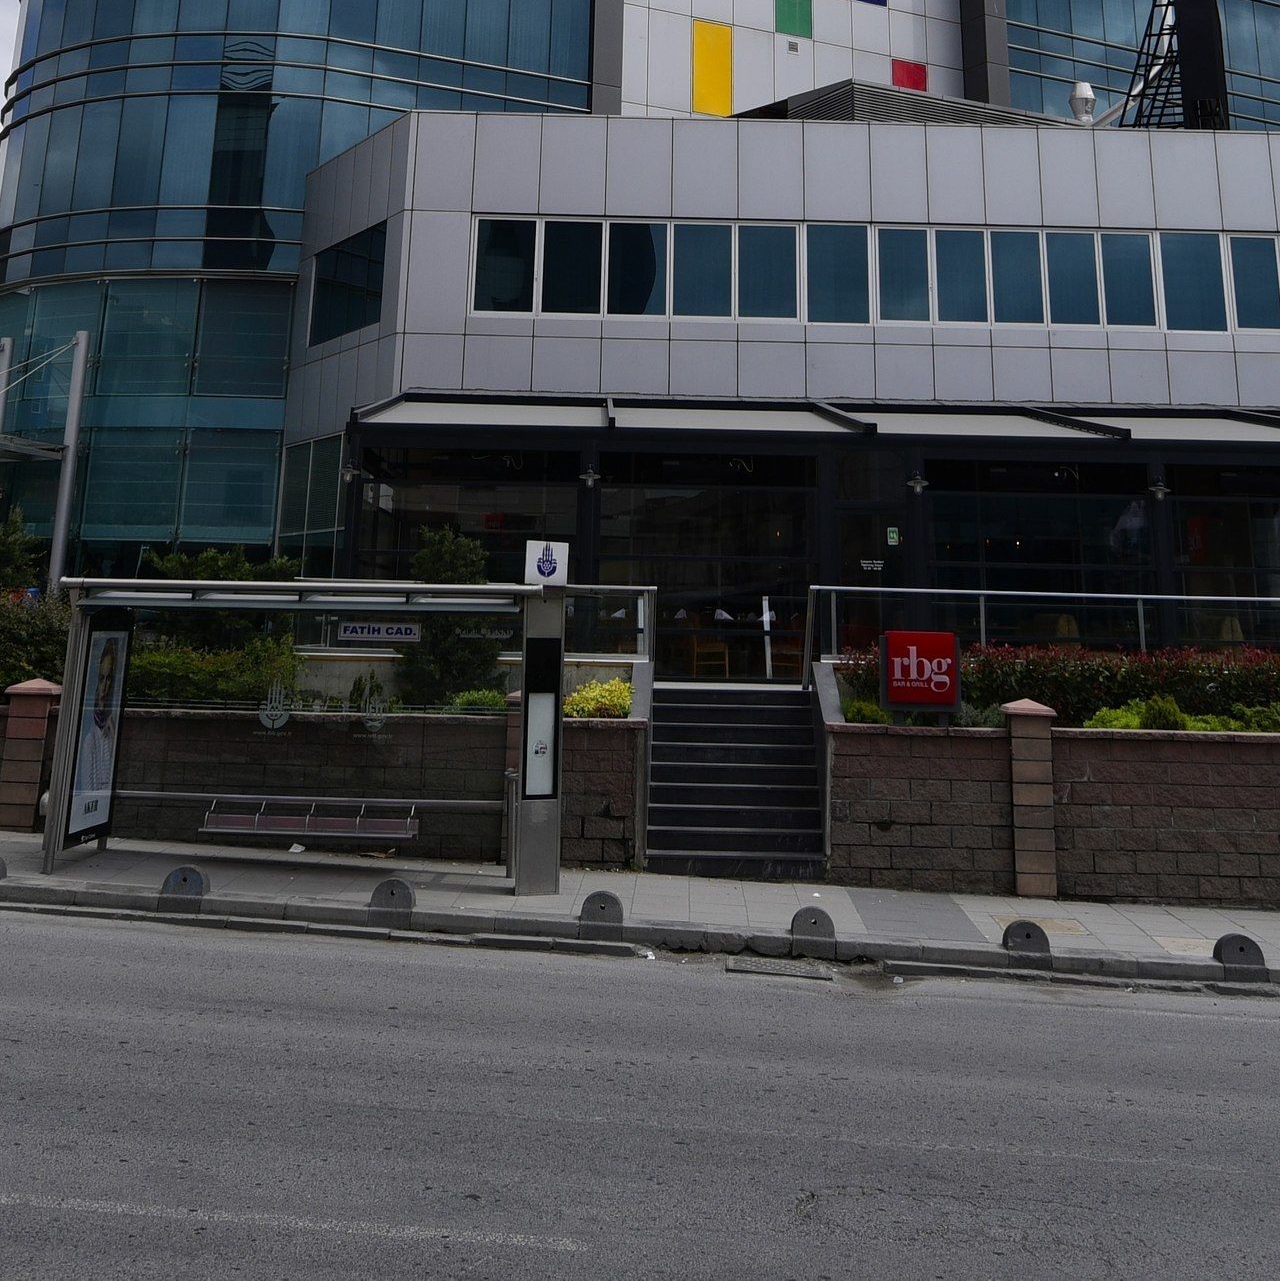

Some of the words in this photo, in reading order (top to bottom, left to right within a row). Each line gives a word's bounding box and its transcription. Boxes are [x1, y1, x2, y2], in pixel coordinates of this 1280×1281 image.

[343, 623, 381, 636] FATİH
[385, 626, 417, 636] CAD.
[891, 646, 952, 692] rbg
